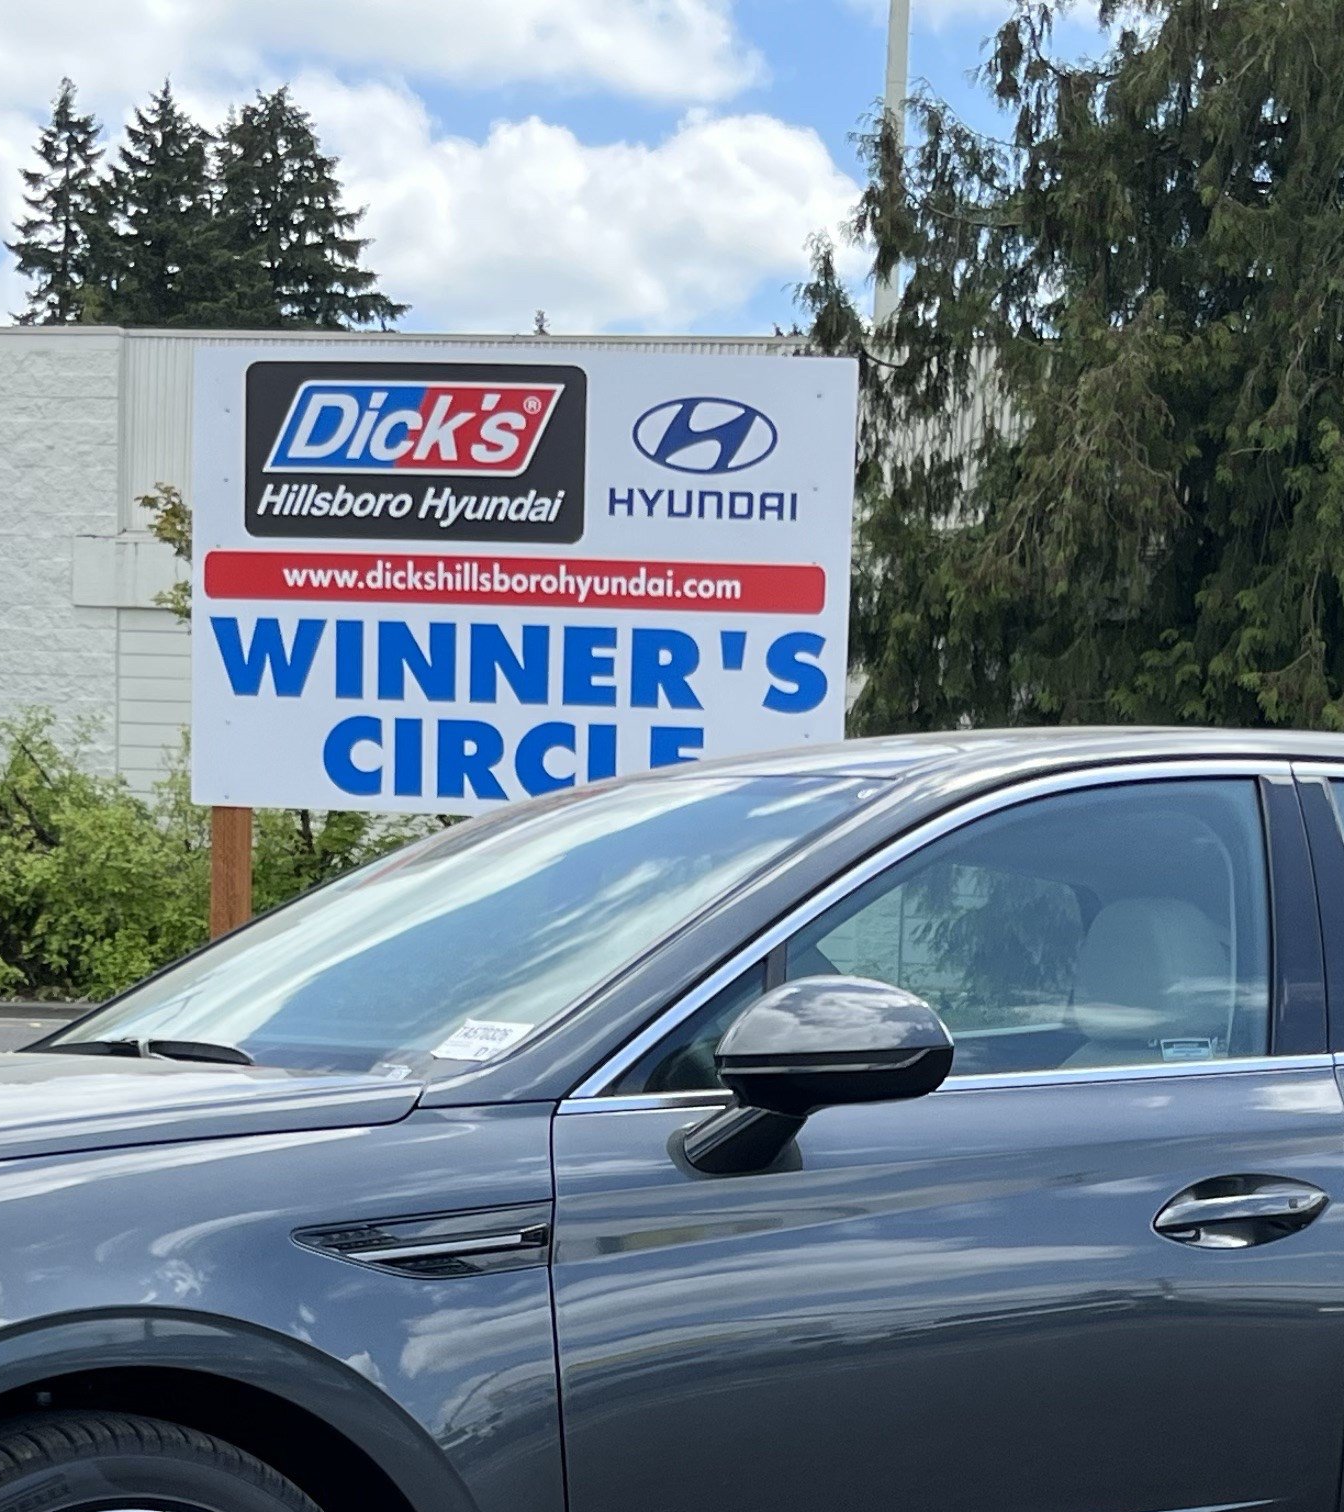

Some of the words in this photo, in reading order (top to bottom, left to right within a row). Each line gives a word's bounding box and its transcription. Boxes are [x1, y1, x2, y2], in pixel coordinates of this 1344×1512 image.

[287, 391, 527, 464] Dick's
[256, 484, 414, 518] Hillsboro
[417, 487, 566, 528] Hyundai
[609, 488, 798, 522] HYUNDAI
[282, 562, 742, 604] www.dickshillsborohyundai.com
[210, 616, 830, 714] WINNER'S
